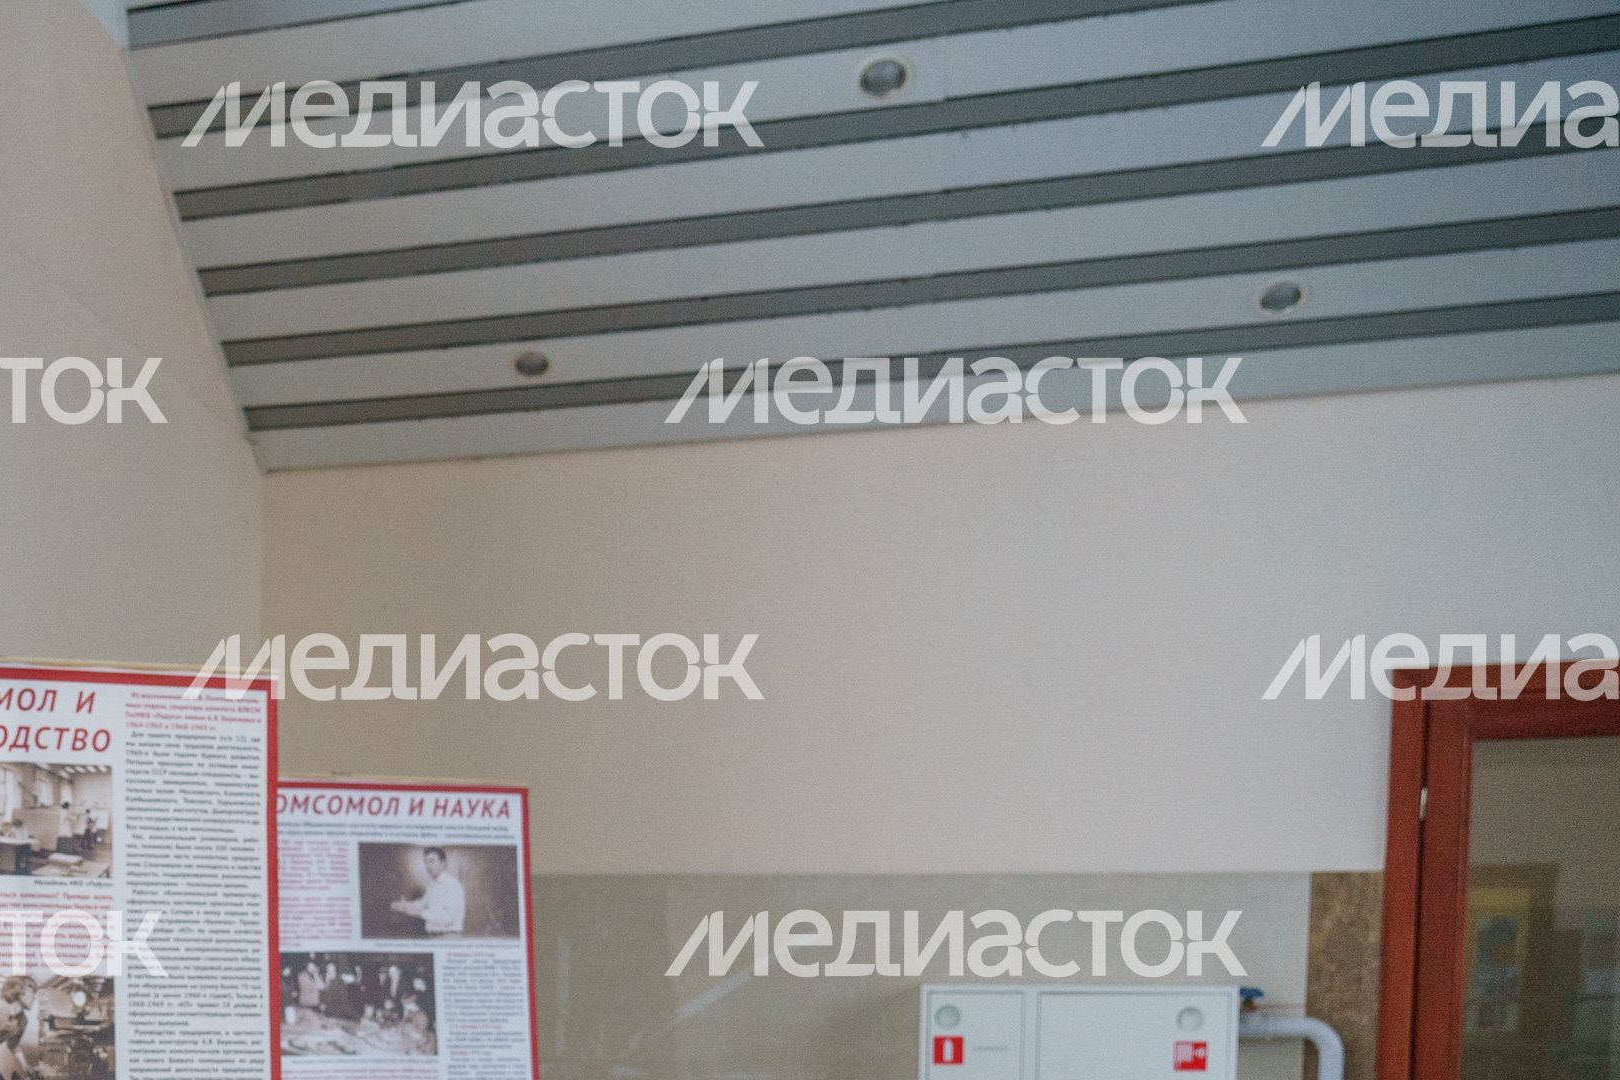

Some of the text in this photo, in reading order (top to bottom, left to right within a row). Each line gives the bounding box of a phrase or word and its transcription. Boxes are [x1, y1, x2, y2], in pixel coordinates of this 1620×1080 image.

[76, 691, 95, 714] И
[278, 793, 510, 819] ОМСОМОЛ И НАУКА
